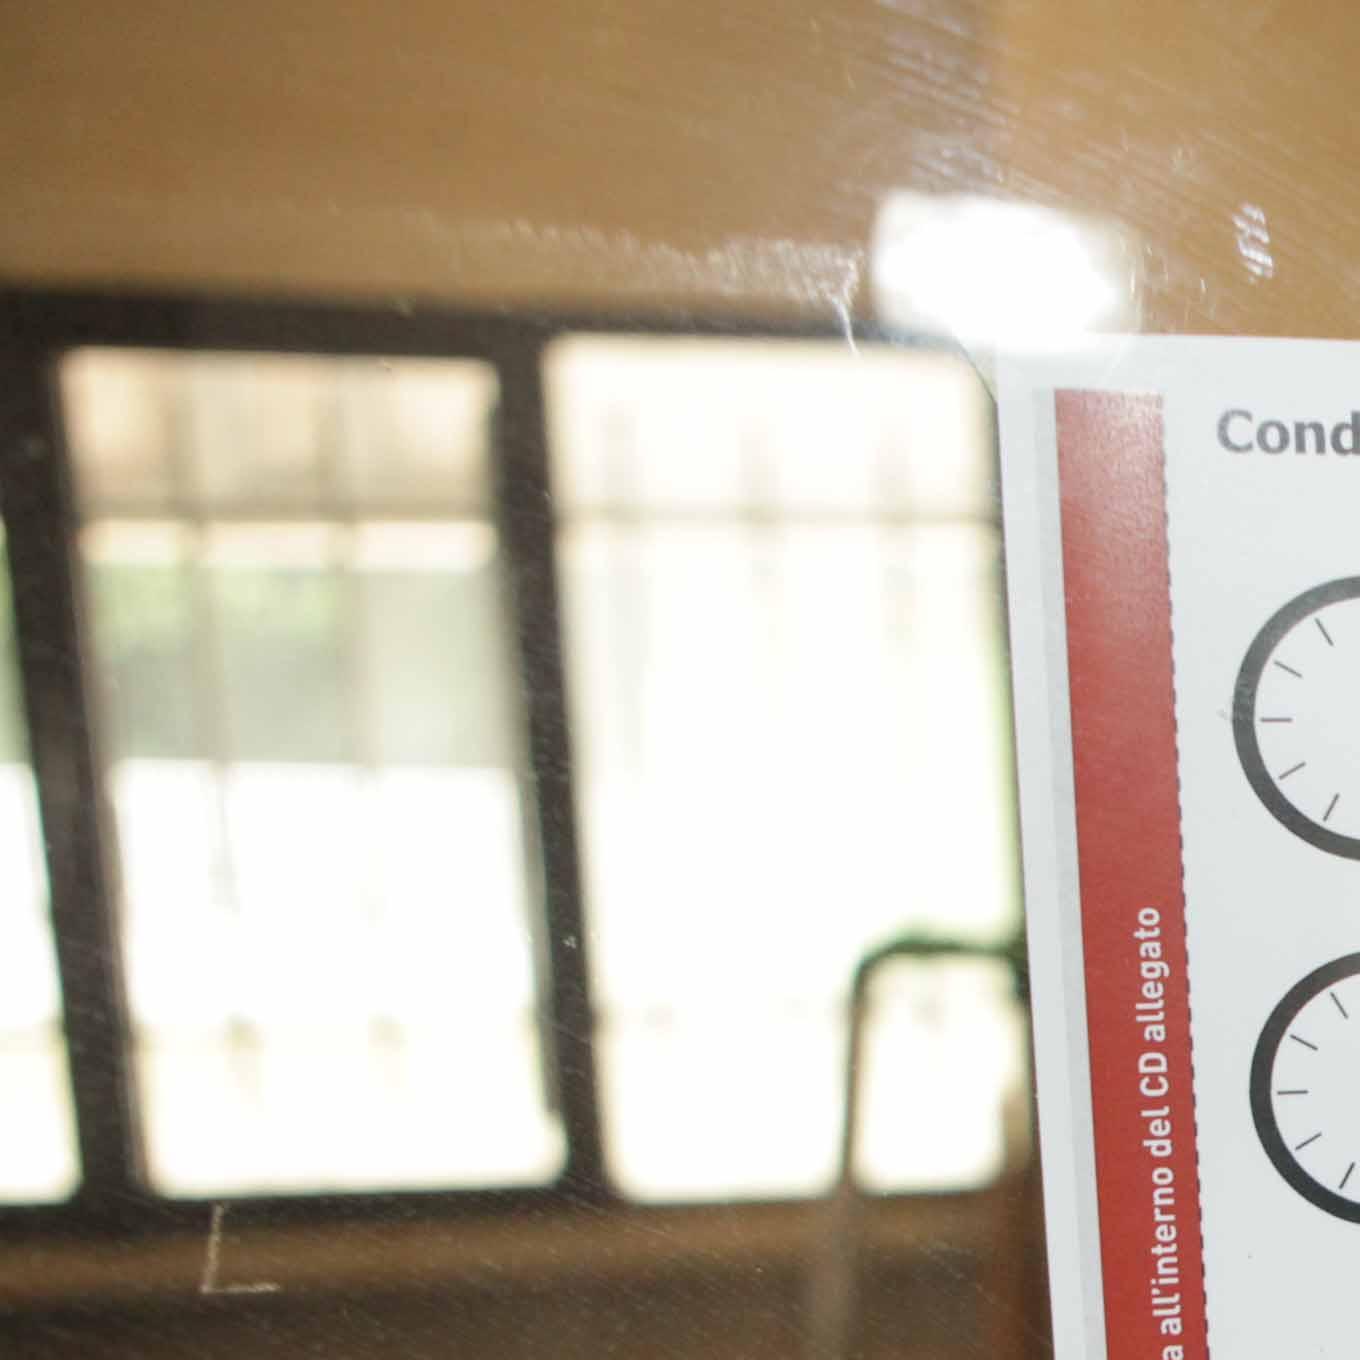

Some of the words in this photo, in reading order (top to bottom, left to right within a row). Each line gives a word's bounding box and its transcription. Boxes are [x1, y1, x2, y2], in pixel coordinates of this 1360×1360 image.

[1136, 908, 1169, 1040] allegato
[1139, 1051, 1169, 1096] CD
[1141, 1105, 1173, 1158] del
[1151, 1167, 1183, 1334] all'interno
